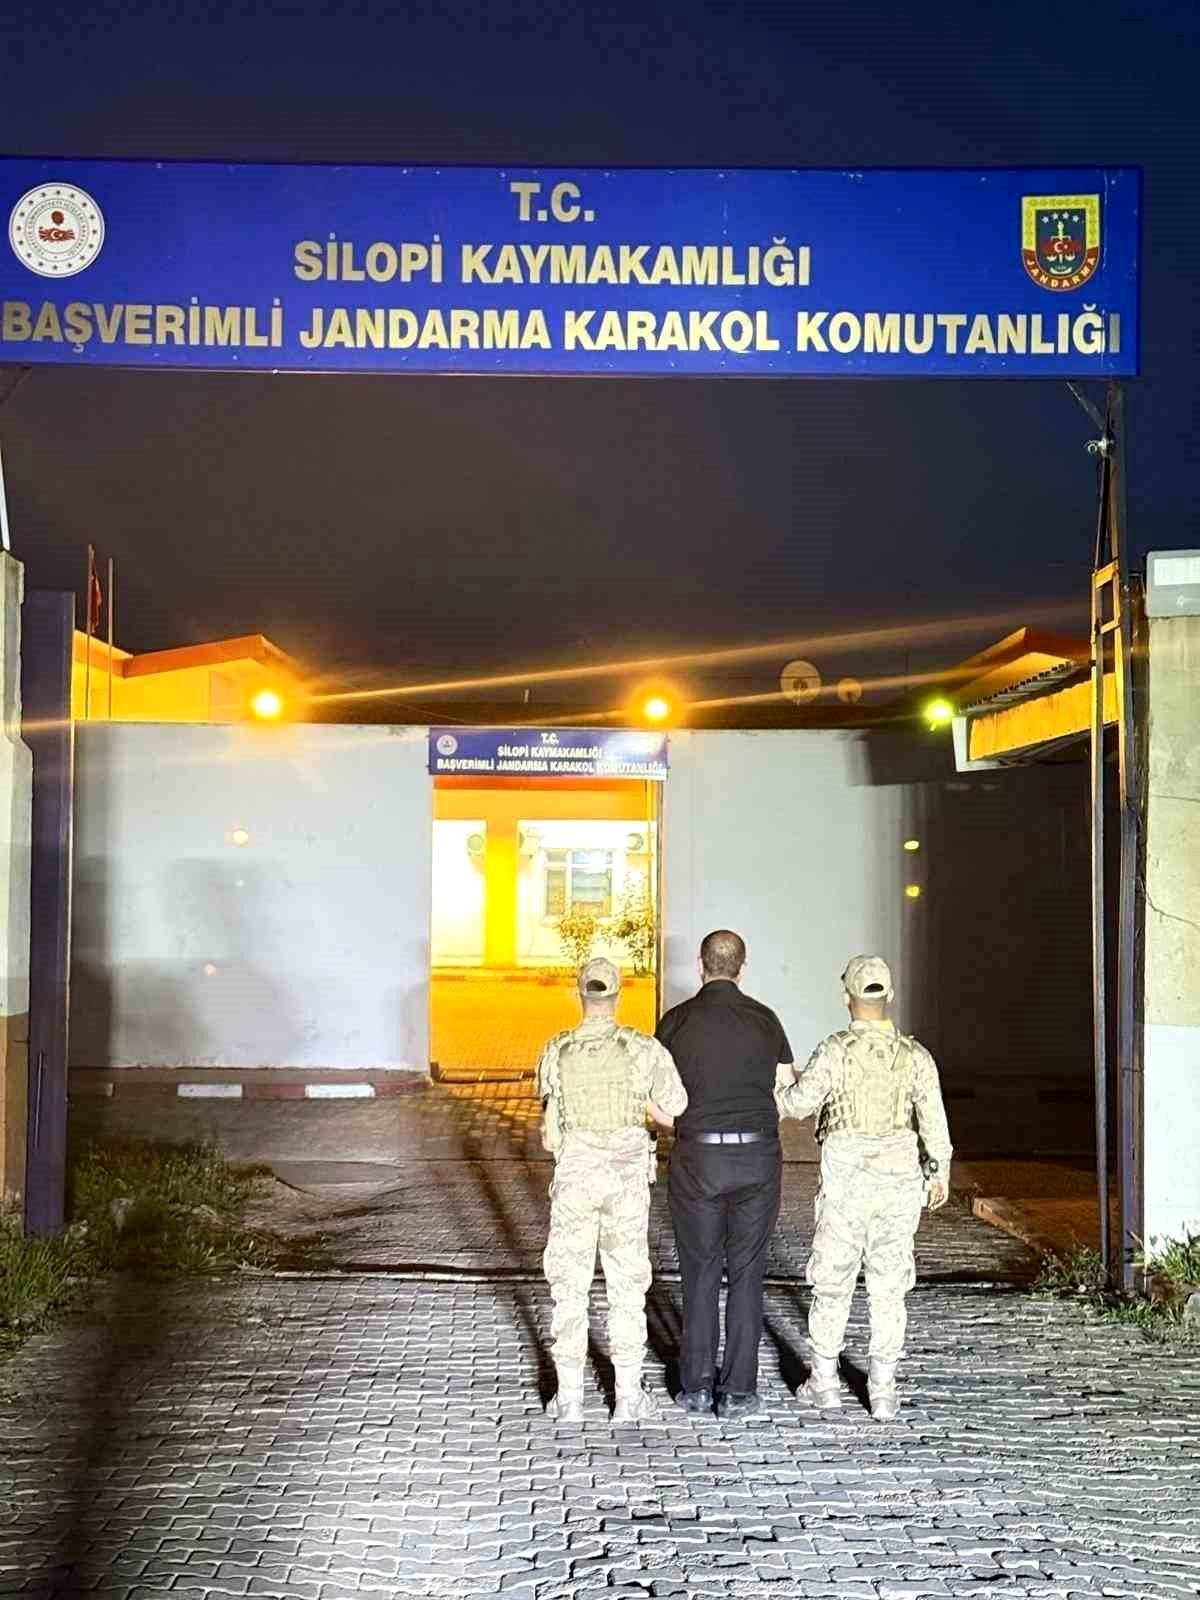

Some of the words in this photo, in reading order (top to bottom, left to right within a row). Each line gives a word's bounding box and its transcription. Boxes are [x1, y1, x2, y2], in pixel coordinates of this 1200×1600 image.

[510, 182, 595, 222] T.C.
[293, 232, 444, 284] SİLOPİ
[461, 236, 811, 287] KAYMAKAMLIĞI
[1026, 257, 1096, 288] JANDARMA
[2, 296, 283, 353] BAŞVERİMLİ
[300, 308, 552, 350] JANDARMA
[564, 310, 780, 353] KARAKOL
[796, 303, 1121, 354] KOMUTANLIĞI
[497, 744, 529, 757] SİLOPİ
[531, 745, 602, 759] KAYMAKAMLIĞI
[541, 732, 559, 745] T.C.
[437, 757, 494, 771] BAŞVERİMLİ
[496, 760, 548, 771] JANDARMA
[550, 761, 594, 773] KARAKOL
